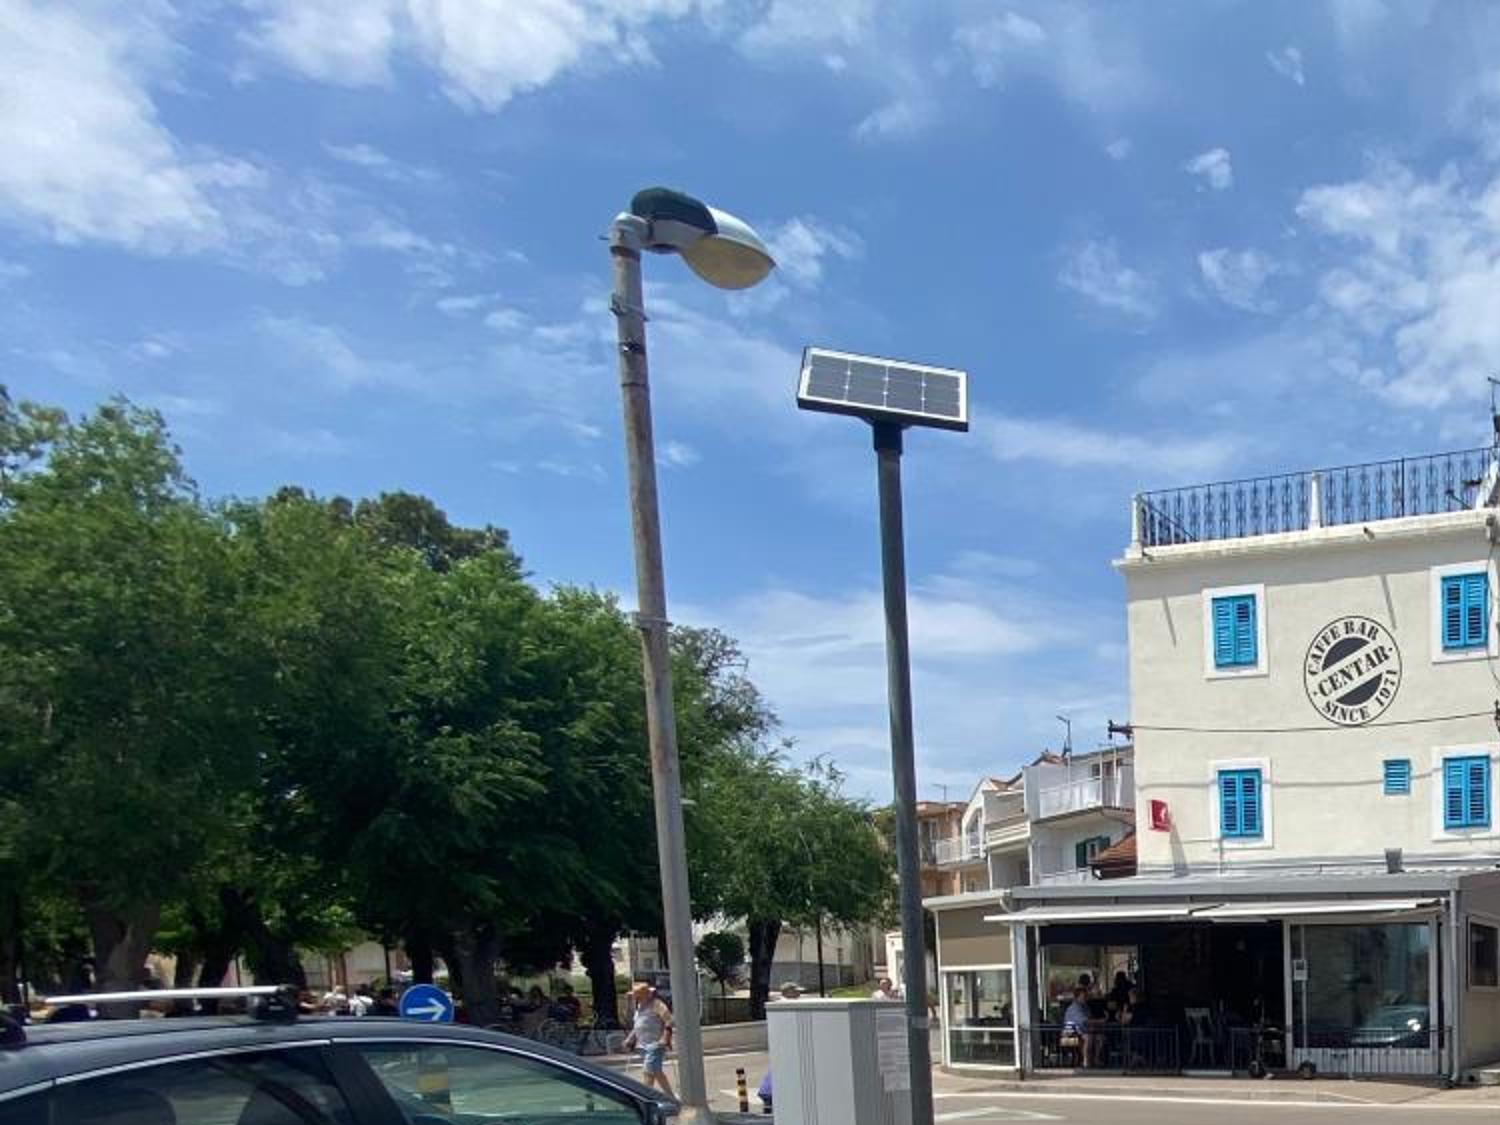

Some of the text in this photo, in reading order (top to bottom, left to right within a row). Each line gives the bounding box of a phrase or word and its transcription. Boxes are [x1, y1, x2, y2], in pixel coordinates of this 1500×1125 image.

[1307, 621, 1379, 676] CAFFE BAR
[1322, 701, 1371, 722] SINCE
